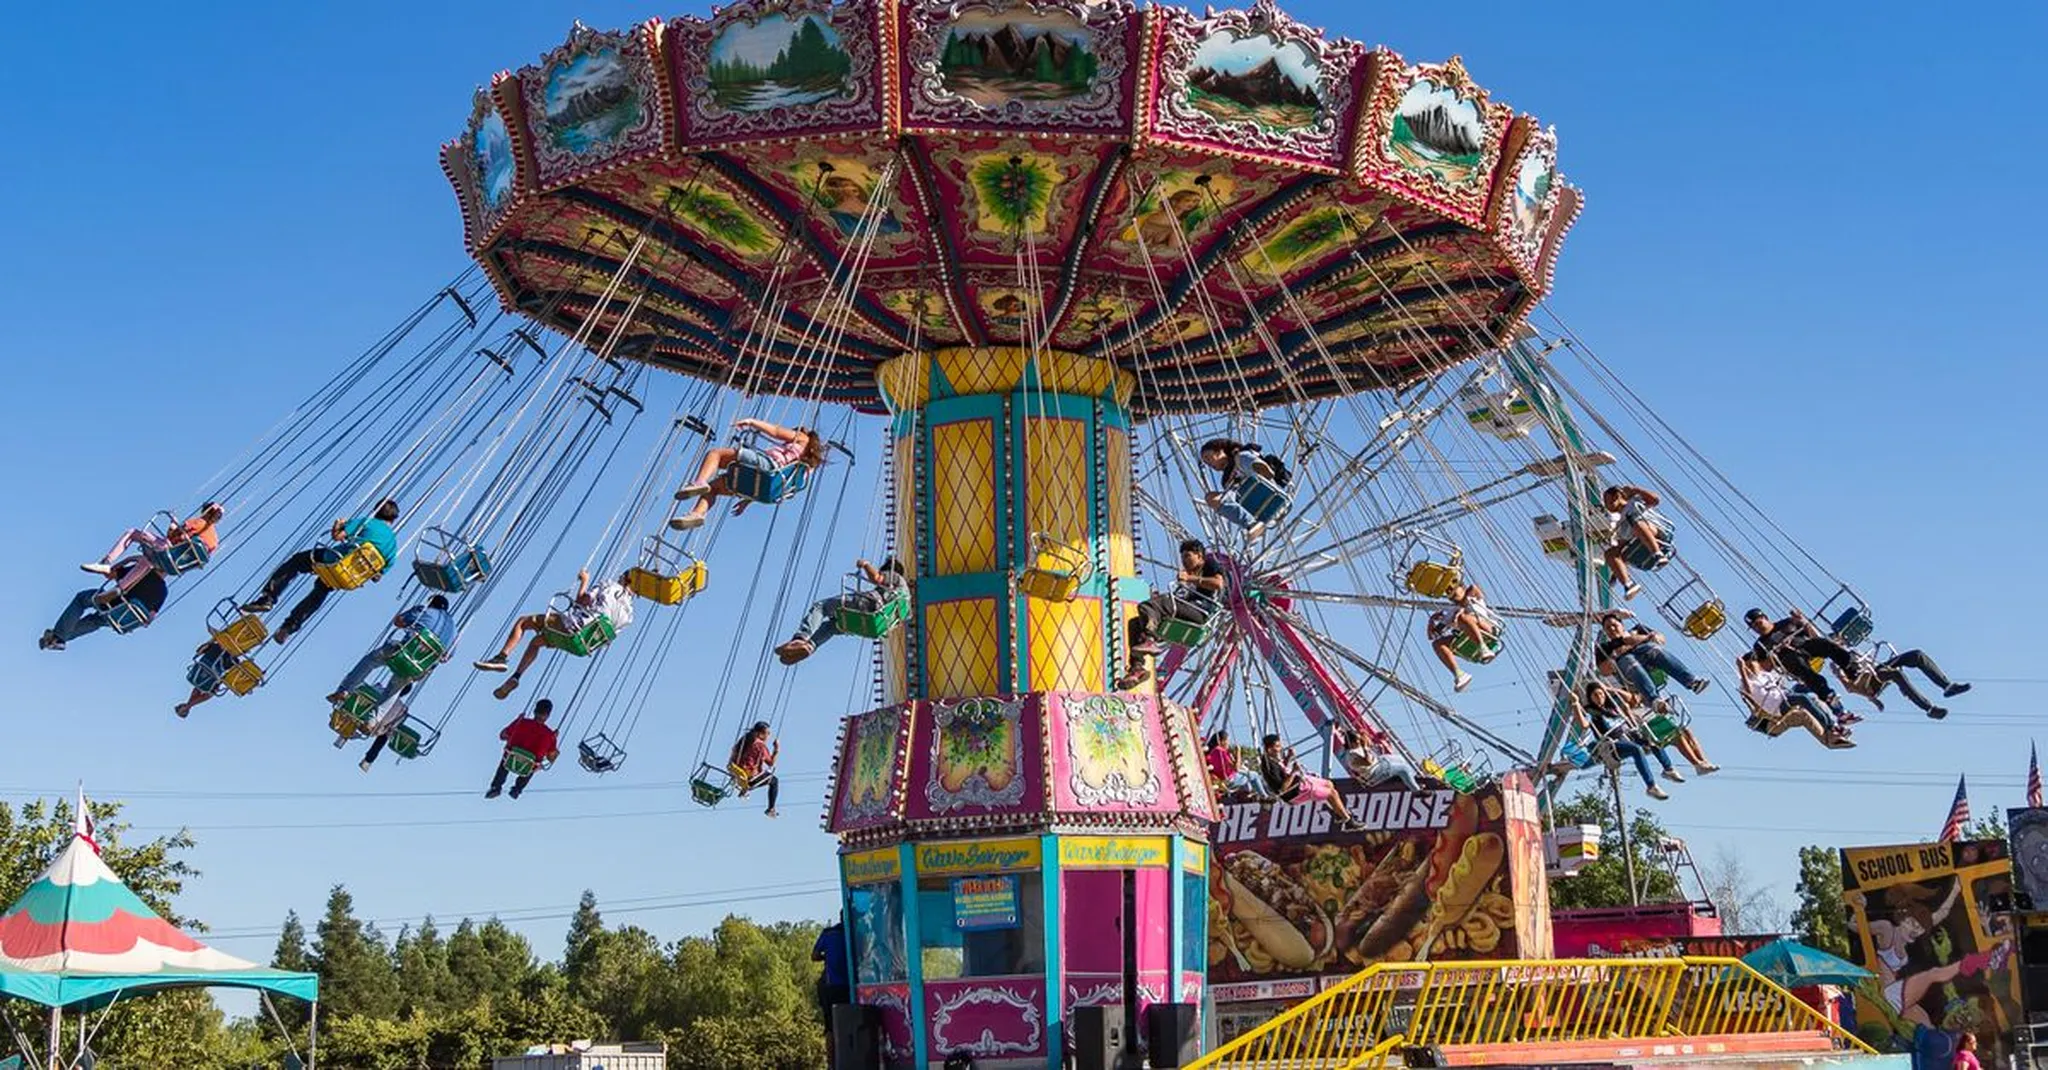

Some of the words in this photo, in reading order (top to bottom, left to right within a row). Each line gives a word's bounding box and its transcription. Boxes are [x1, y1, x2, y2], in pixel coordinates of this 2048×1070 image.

[1217, 802, 1260, 843] HE
[1267, 799, 1332, 838] DOG
[1345, 789, 1455, 831] HOUSE
[1857, 853, 1914, 880] SCHOOL
[1919, 845, 1949, 869] BUS
